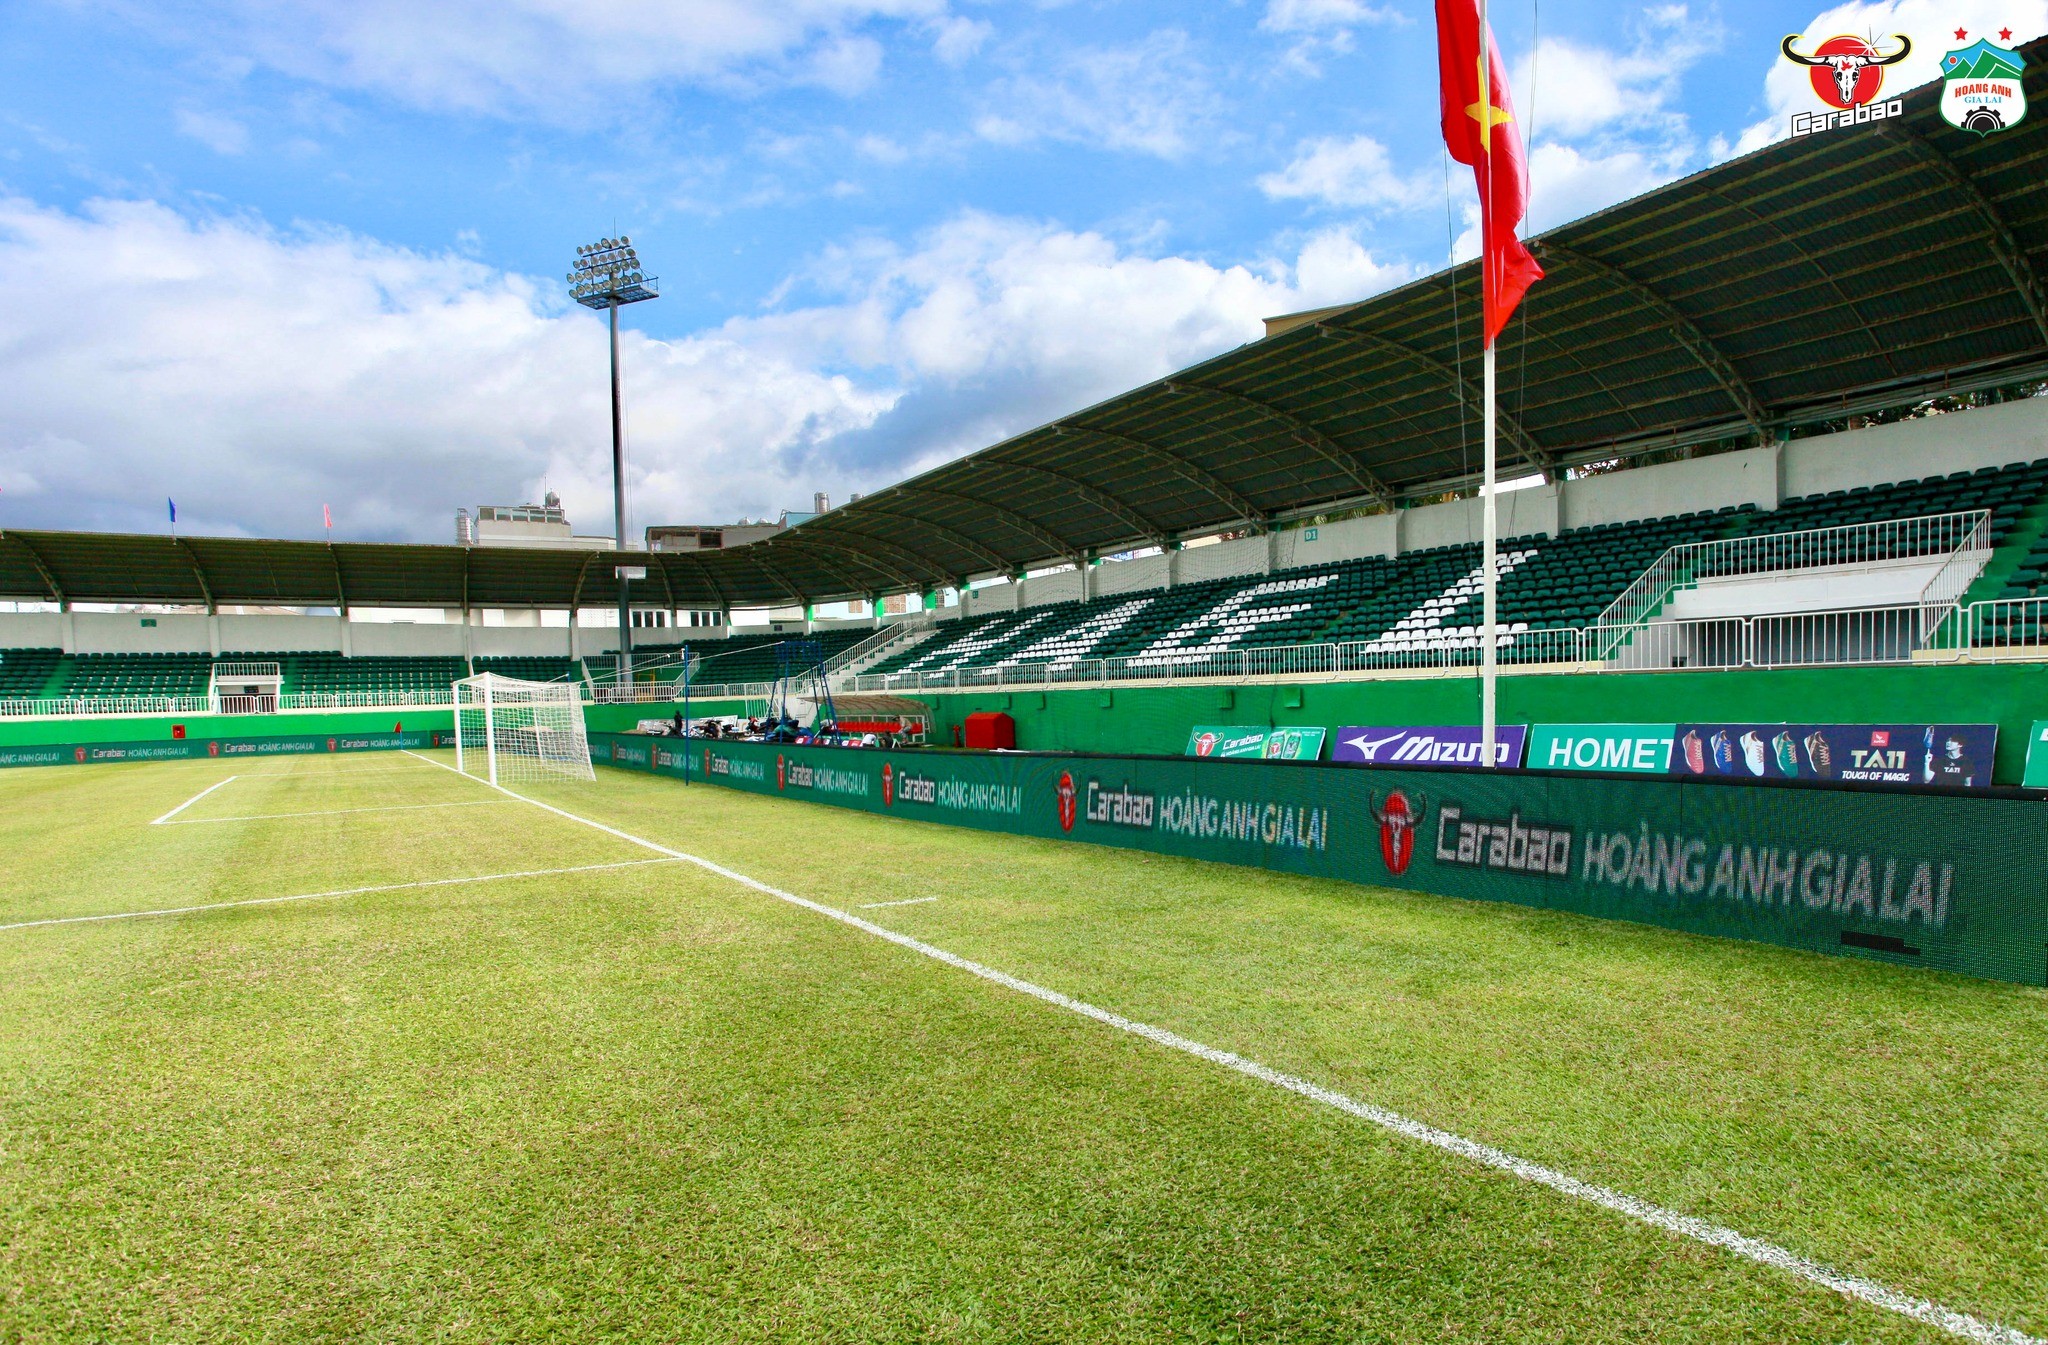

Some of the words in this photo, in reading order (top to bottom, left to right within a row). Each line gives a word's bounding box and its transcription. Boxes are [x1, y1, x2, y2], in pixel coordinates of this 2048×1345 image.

[225, 743, 256, 753] Carabao
[258, 742, 281, 752] HOÀNG
[341, 739, 369, 748] Carabao
[1223, 734, 1264, 750] Carabao
[18, 753, 34, 763] ANH
[35, 752, 48, 762] GIA
[48, 752, 60, 762] LAI
[93, 748, 126, 758] Carabao
[128, 746, 152, 757] HOÀNG
[788, 760, 813, 787] Carabao
[814, 763, 834, 792] HOÀNG
[835, 769, 848, 793] ANH
[848, 771, 858, 795] GIA
[859, 772, 868, 796] LAI
[1842, 770, 1868, 780] TOUCH
[1869, 771, 1883, 781] OF
[1883, 772, 1910, 782] MAGIC
[899, 771, 935, 803] Carabao
[938, 774, 968, 809] HOÀNG
[969, 783, 989, 811] ANH
[989, 784, 1005, 813] GIA
[1007, 786, 1022, 815] LAI
[1087, 781, 1153, 827] Carabao
[1159, 786, 1218, 837] HOÀNG
[1219, 800, 1260, 841] ANH
[1261, 803, 1294, 846] GIA
[1297, 807, 1328, 850] LAI
[1437, 806, 1573, 875] Carabao
[1583, 822, 1707, 896] HOÀNG
[1708, 841, 1796, 905] ANH
[1800, 849, 1879, 916] GIA
[1880, 857, 1955, 928] LAI
